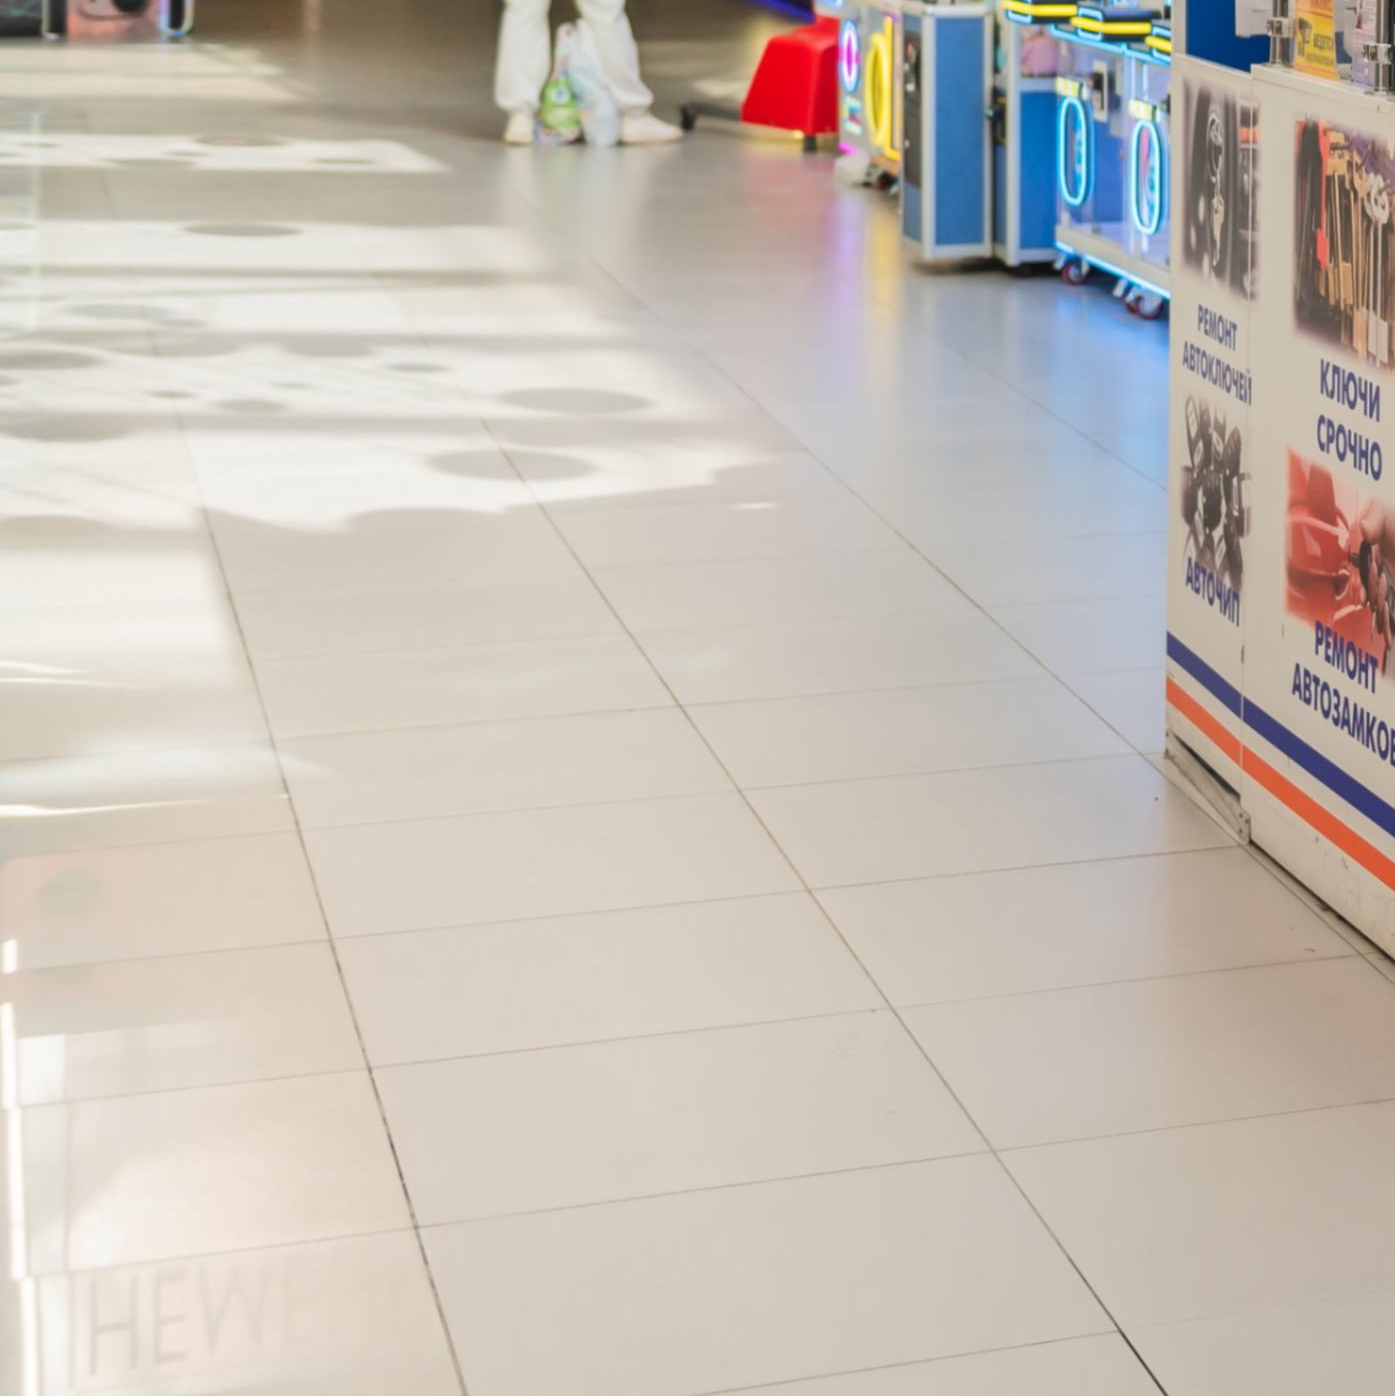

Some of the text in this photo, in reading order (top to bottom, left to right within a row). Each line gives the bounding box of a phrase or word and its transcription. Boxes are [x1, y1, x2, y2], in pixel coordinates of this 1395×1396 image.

[1198, 303, 1237, 352] РЕМОНТ
[1183, 341, 1252, 405] АВТОКЛЮЧЕЙ
[1320, 359, 1381, 422] КЛЮЧИ
[1317, 415, 1382, 481] СРОЧНО
[1186, 557, 1240, 627] АВТОЧИП
[1315, 621, 1378, 694] РЕМОНТ
